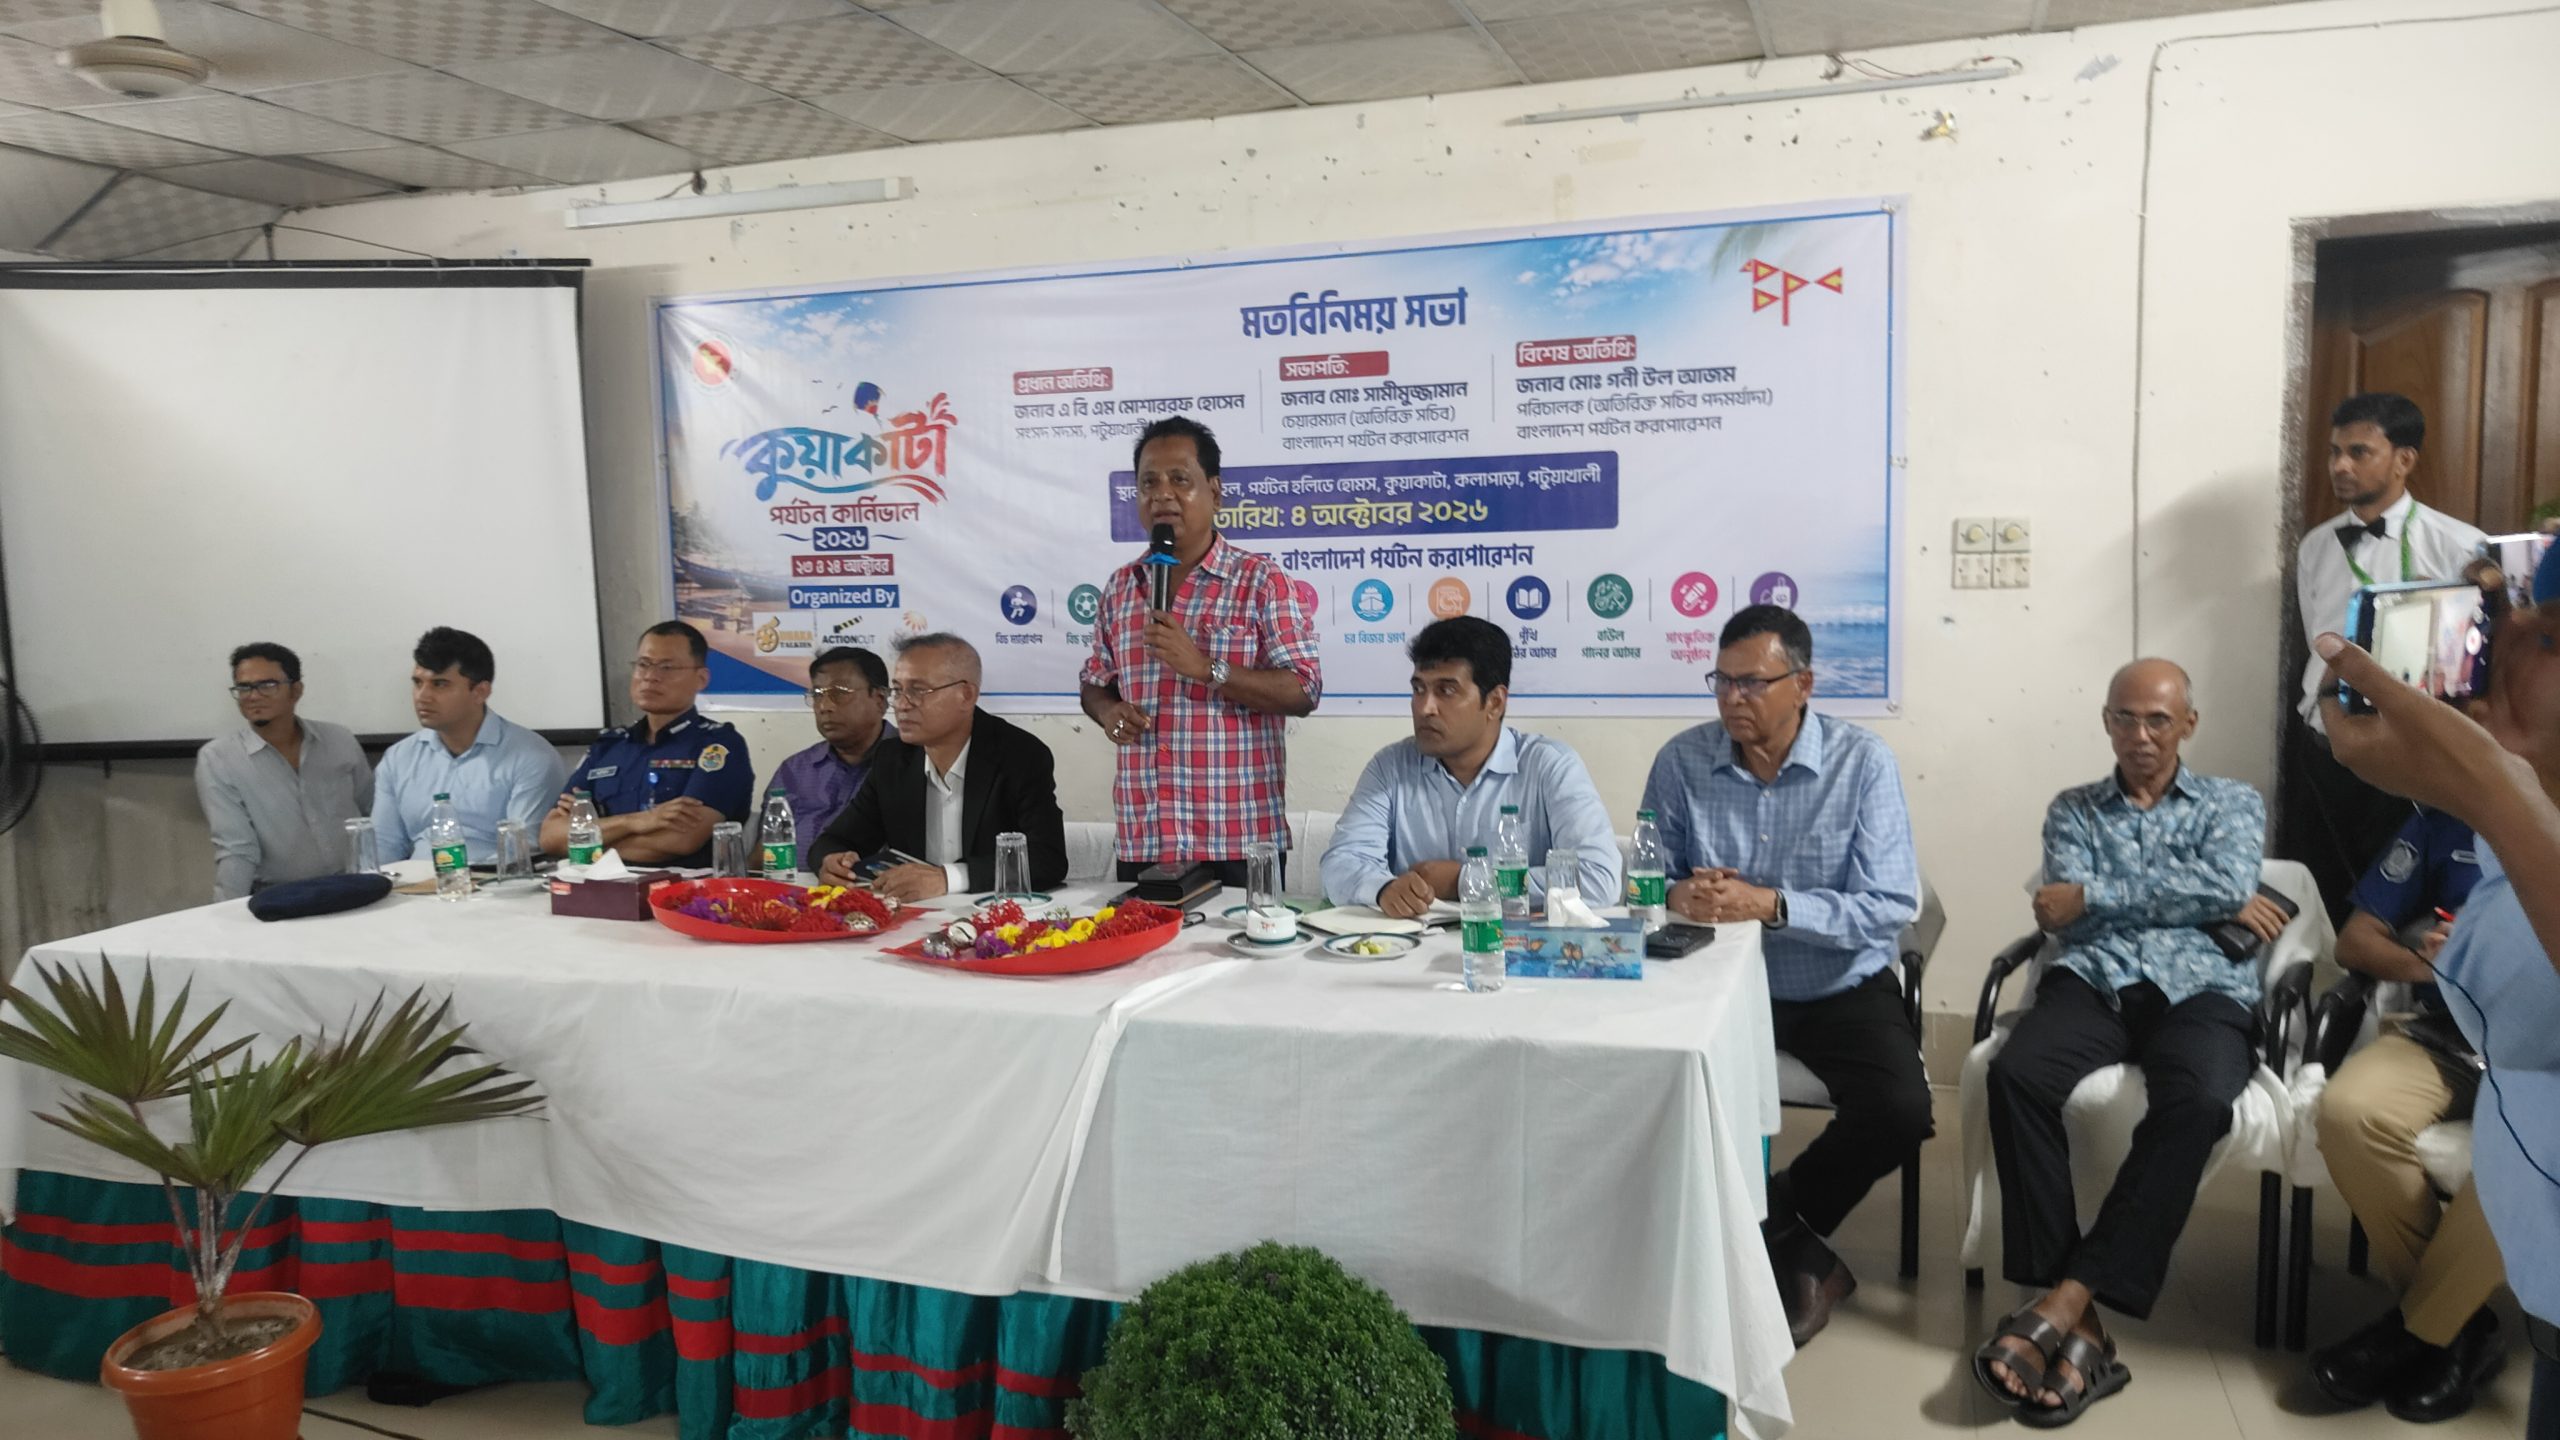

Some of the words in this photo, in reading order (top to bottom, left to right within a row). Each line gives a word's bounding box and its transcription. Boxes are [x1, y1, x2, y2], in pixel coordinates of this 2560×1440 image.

[1240, 289, 1397, 339] মতবিনিময়
[1403, 286, 1468, 328] সভা
[1518, 342, 1571, 364] বিশেষ
[1018, 375, 1055, 395] প্রধান
[1516, 376, 1565, 393] জনাব
[1569, 374, 1602, 391] মোঃ
[1607, 366, 1638, 389] গনী
[1642, 367, 1673, 387] উল
[1677, 365, 1736, 385] আজম
[1014, 403, 1055, 419] জনাব
[1058, 402, 1071, 417] এ
[1073, 397, 1088, 416] বি
[1092, 400, 1115, 415] এম
[1118, 397, 1194, 415] মোশাররফ
[1197, 394, 1245, 412] হোসেন
[1281, 389, 1326, 406] জনাব
[1330, 387, 1360, 404] মোঃ
[1517, 398, 1585, 417] পরিচালক
[1588, 393, 1658, 415] (অতিরিক্ত
[1660, 390, 1698, 409] সচিব
[1282, 411, 1346, 430] চেয়ারম্যান
[1350, 406, 1413, 428] (অতিরিক্ত
[1416, 403, 1456, 422] সচিব)
[1282, 434, 1344, 451] বাংলাদেশ
[1516, 423, 1584, 440] বাংলাদেশ
[720, 391, 958, 502] কুয়াকাটা
[1248, 476, 1289, 495] পর্যটন
[1291, 475, 1334, 494] হলিডে
[1527, 462, 1602, 491] পটুয়াখালী
[769, 497, 827, 525] পর্যটন
[830, 494, 921, 524] কার্নিভাল
[1213, 499, 1285, 530] তারিখ:
[1291, 505, 1307, 527] ৪
[1311, 496, 1414, 529] অক্টোবর
[1418, 499, 1488, 523] ২০২৬
[815, 529, 867, 549] ২০২৬
[1281, 547, 1366, 571] বাংলাদেশ
[1370, 541, 1423, 569] পর্যটন
[1427, 543, 1535, 570] করপোরেশন
[790, 587, 871, 609] Organized
[875, 587, 896, 608] By
